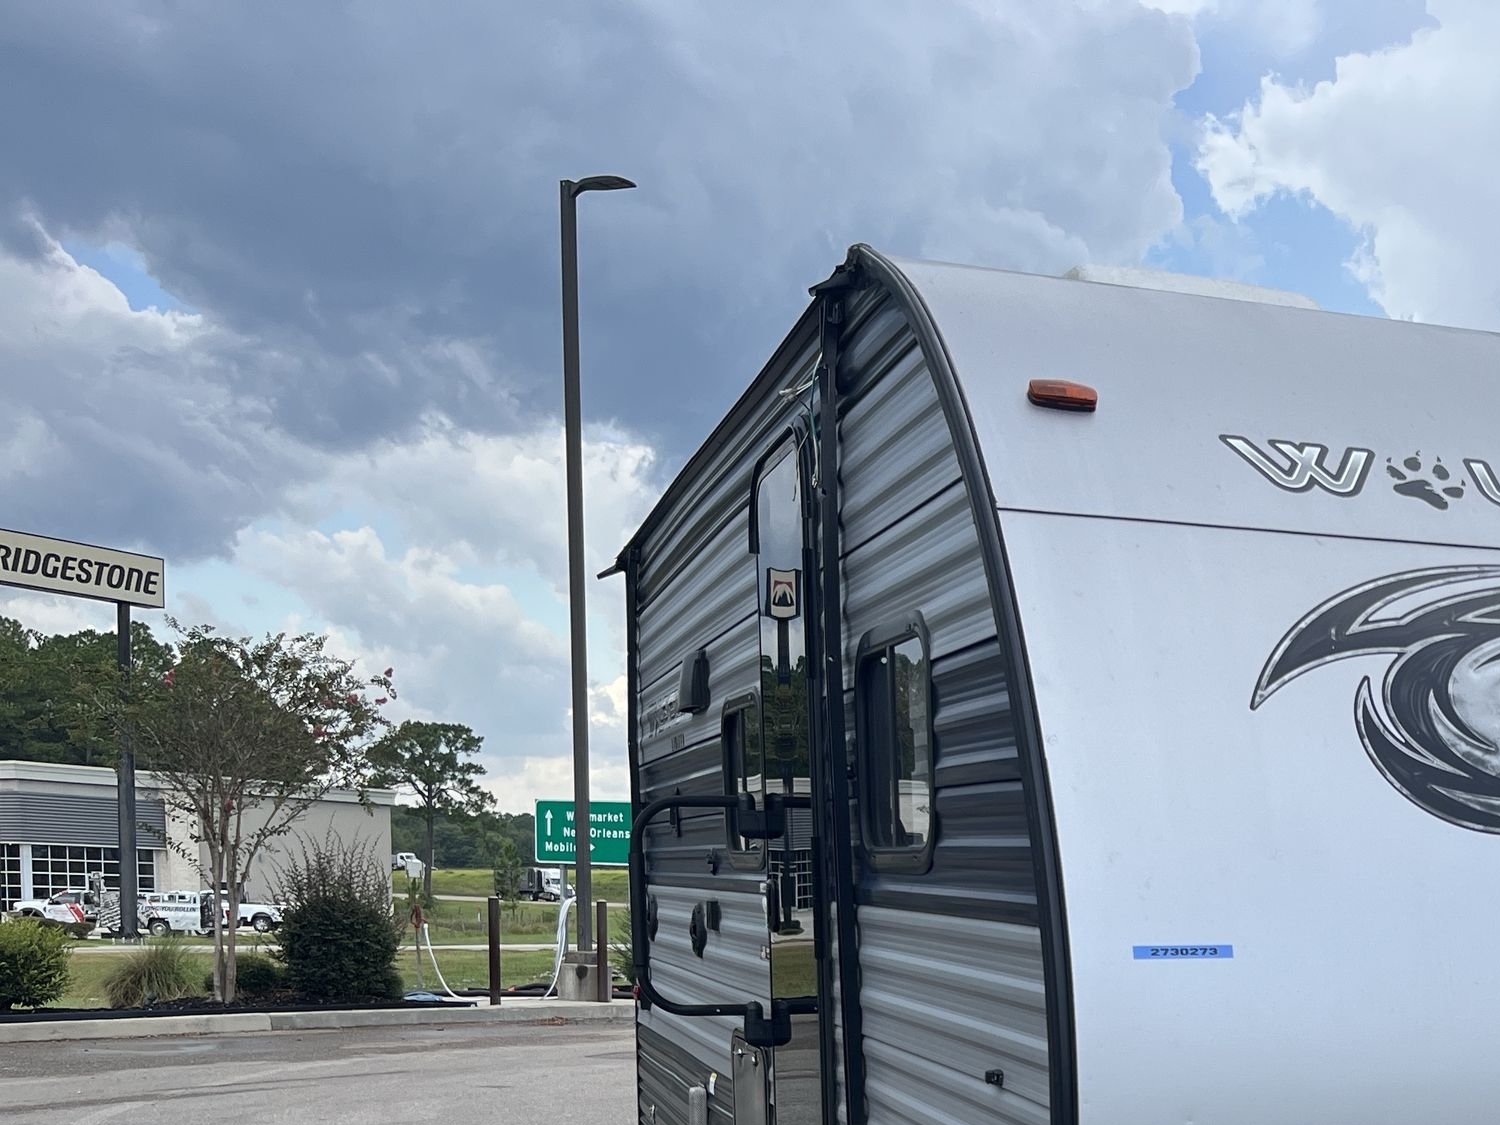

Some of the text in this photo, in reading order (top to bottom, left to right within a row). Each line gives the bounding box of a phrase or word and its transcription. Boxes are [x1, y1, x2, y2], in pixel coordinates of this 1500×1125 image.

[0, 544, 160, 595] RIDGESTONE
[566, 811, 624, 823] Wmarket
[589, 827, 631, 839] Orleans
[1150, 947, 1218, 957] 2730273
